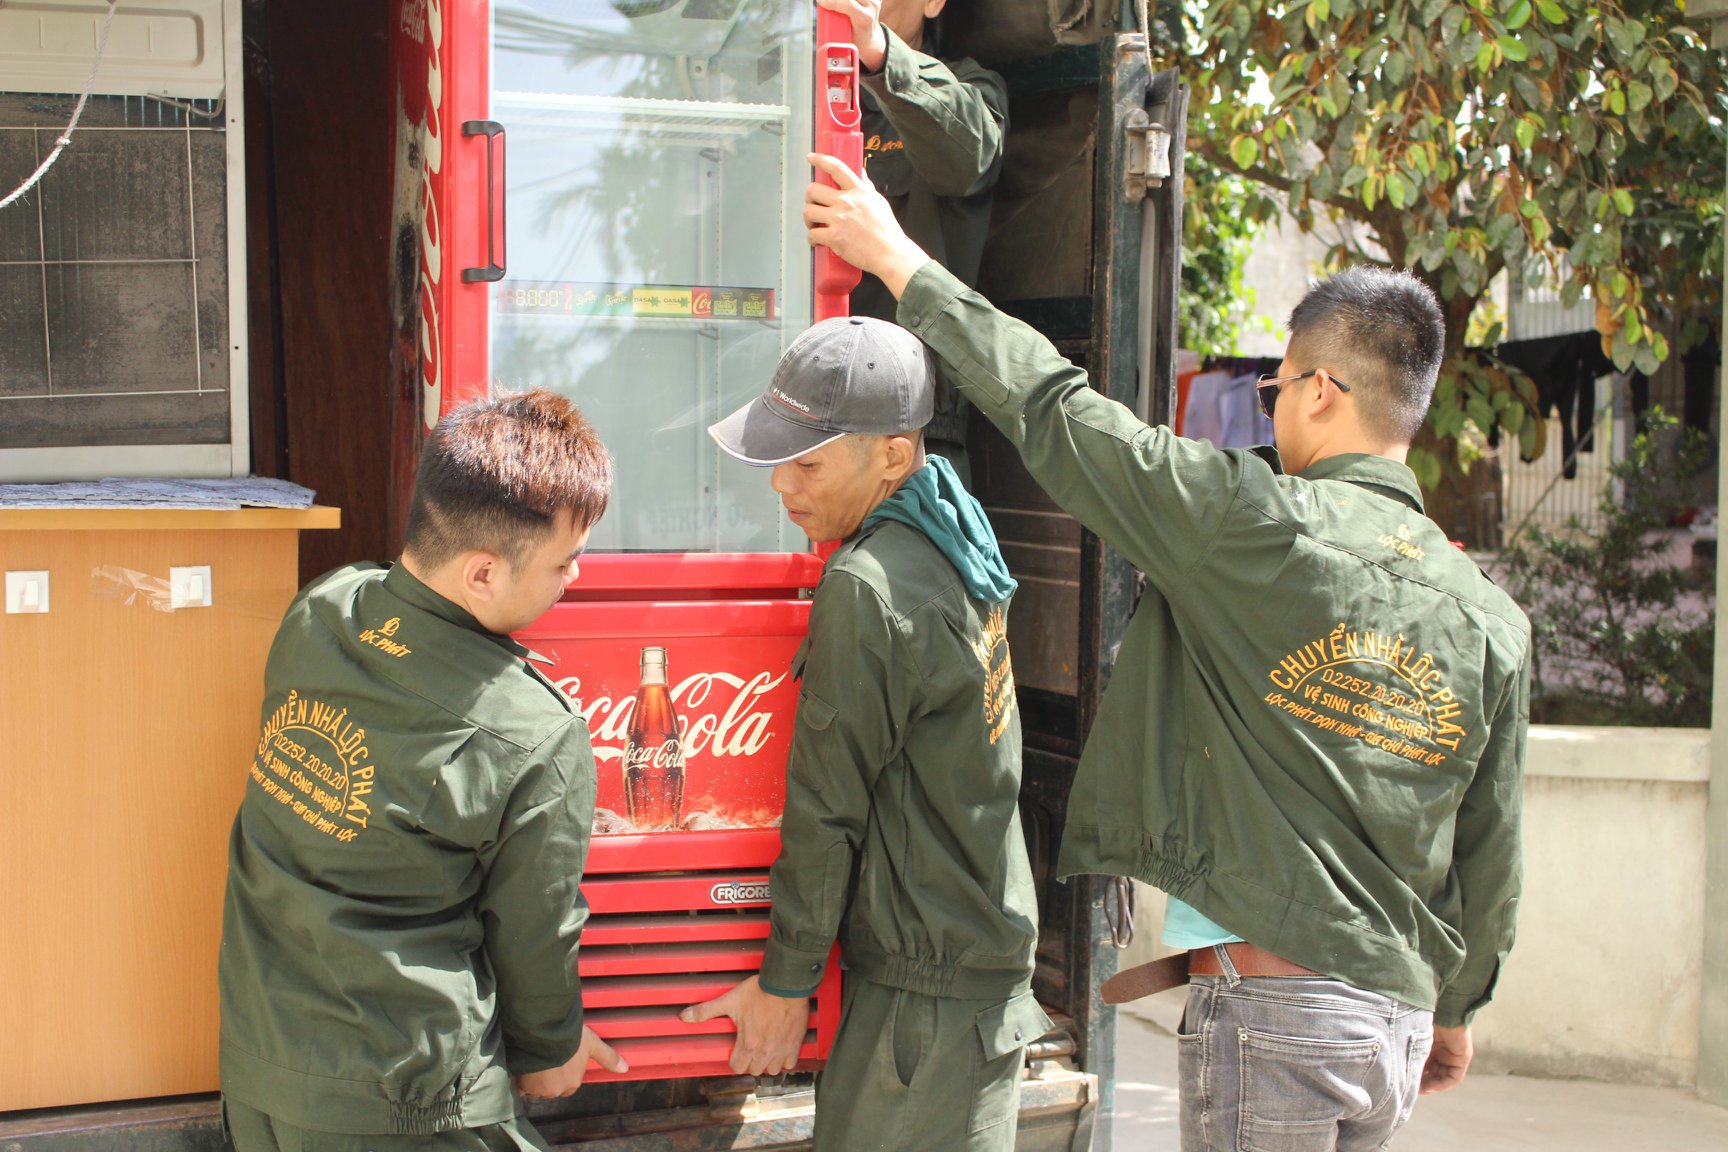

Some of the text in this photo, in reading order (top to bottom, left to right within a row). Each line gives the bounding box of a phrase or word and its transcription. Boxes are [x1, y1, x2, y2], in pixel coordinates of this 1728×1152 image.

[779, 391, 810, 413] Worldwide
[1268, 622, 1467, 752] CHUYỂN NHÀ LỘC PHÁT
[1303, 684, 1430, 741] VỆ SINH CÔNG NGHIỆP
[1320, 668, 1425, 717] 02252.20.20.20
[623, 739, 686, 771] Coca-Cola
[1264, 692, 1288, 708] LỘC
[1283, 701, 1313, 721] PHÁT
[1310, 714, 1338, 732] DỌN
[1334, 721, 1364, 738] NHÀ
[1364, 731, 1385, 746] GIA
[1382, 737, 1405, 757] CHỦ
[1399, 745, 1430, 762] PHÁT
[1424, 751, 1447, 766] LỘC
[258, 689, 375, 829] CHUYỂN NHÀ LỘC PHÁT
[269, 756, 292, 780] SINH
[288, 770, 313, 794] CÔNG
[311, 785, 342, 814] NGHIỆP
[273, 732, 346, 790] 02252.20.20.20
[261, 777, 278, 795] DỌN
[274, 785, 295, 805] NHÀ
[314, 816, 340, 836] PHÁT
[336, 828, 359, 843] LỘC
